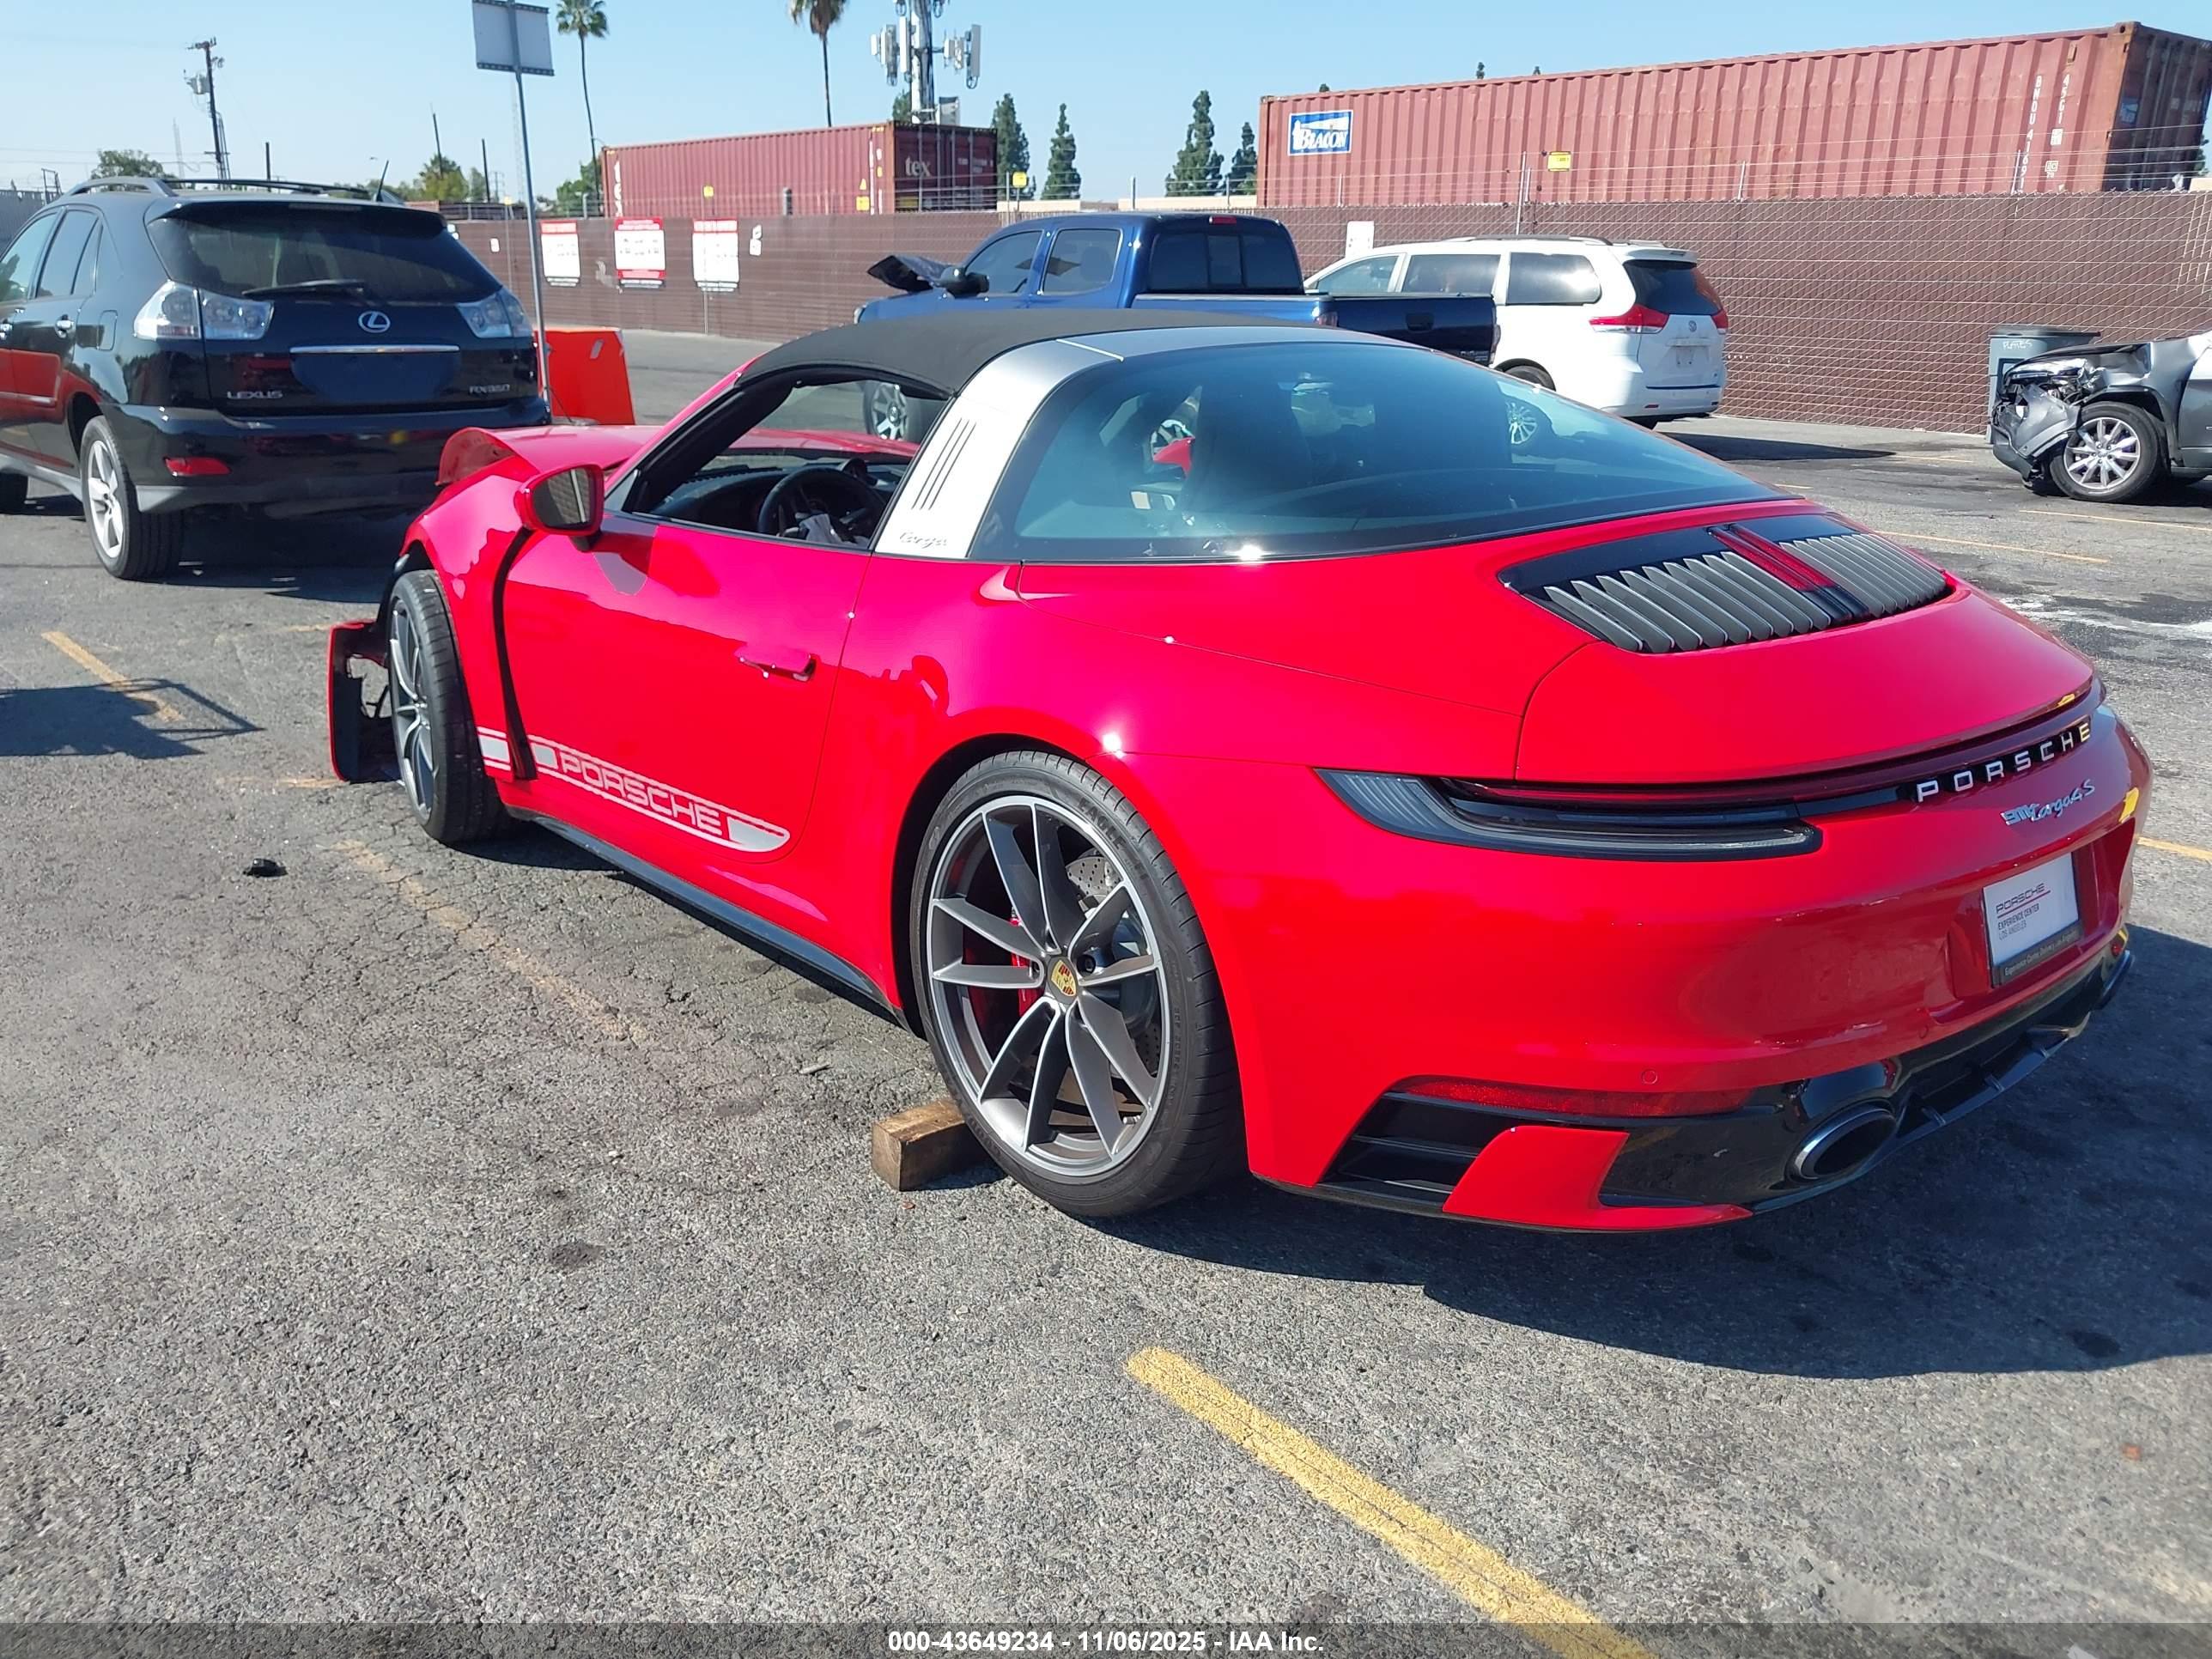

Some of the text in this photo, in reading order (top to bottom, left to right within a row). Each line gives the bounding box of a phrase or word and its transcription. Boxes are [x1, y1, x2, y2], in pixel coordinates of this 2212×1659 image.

[1299, 129, 1348, 149] BEACON
[905, 155, 931, 177] tex
[227, 391, 283, 399] LEXUS
[1916, 722, 2091, 803] PORSCHE
[560, 751, 723, 836] PORSCHE
[1079, 797, 1127, 850] EAGLE
[1996, 883, 2045, 915] PORSCHE
[1998, 902, 2039, 931] EXPERIENCE CENTER
